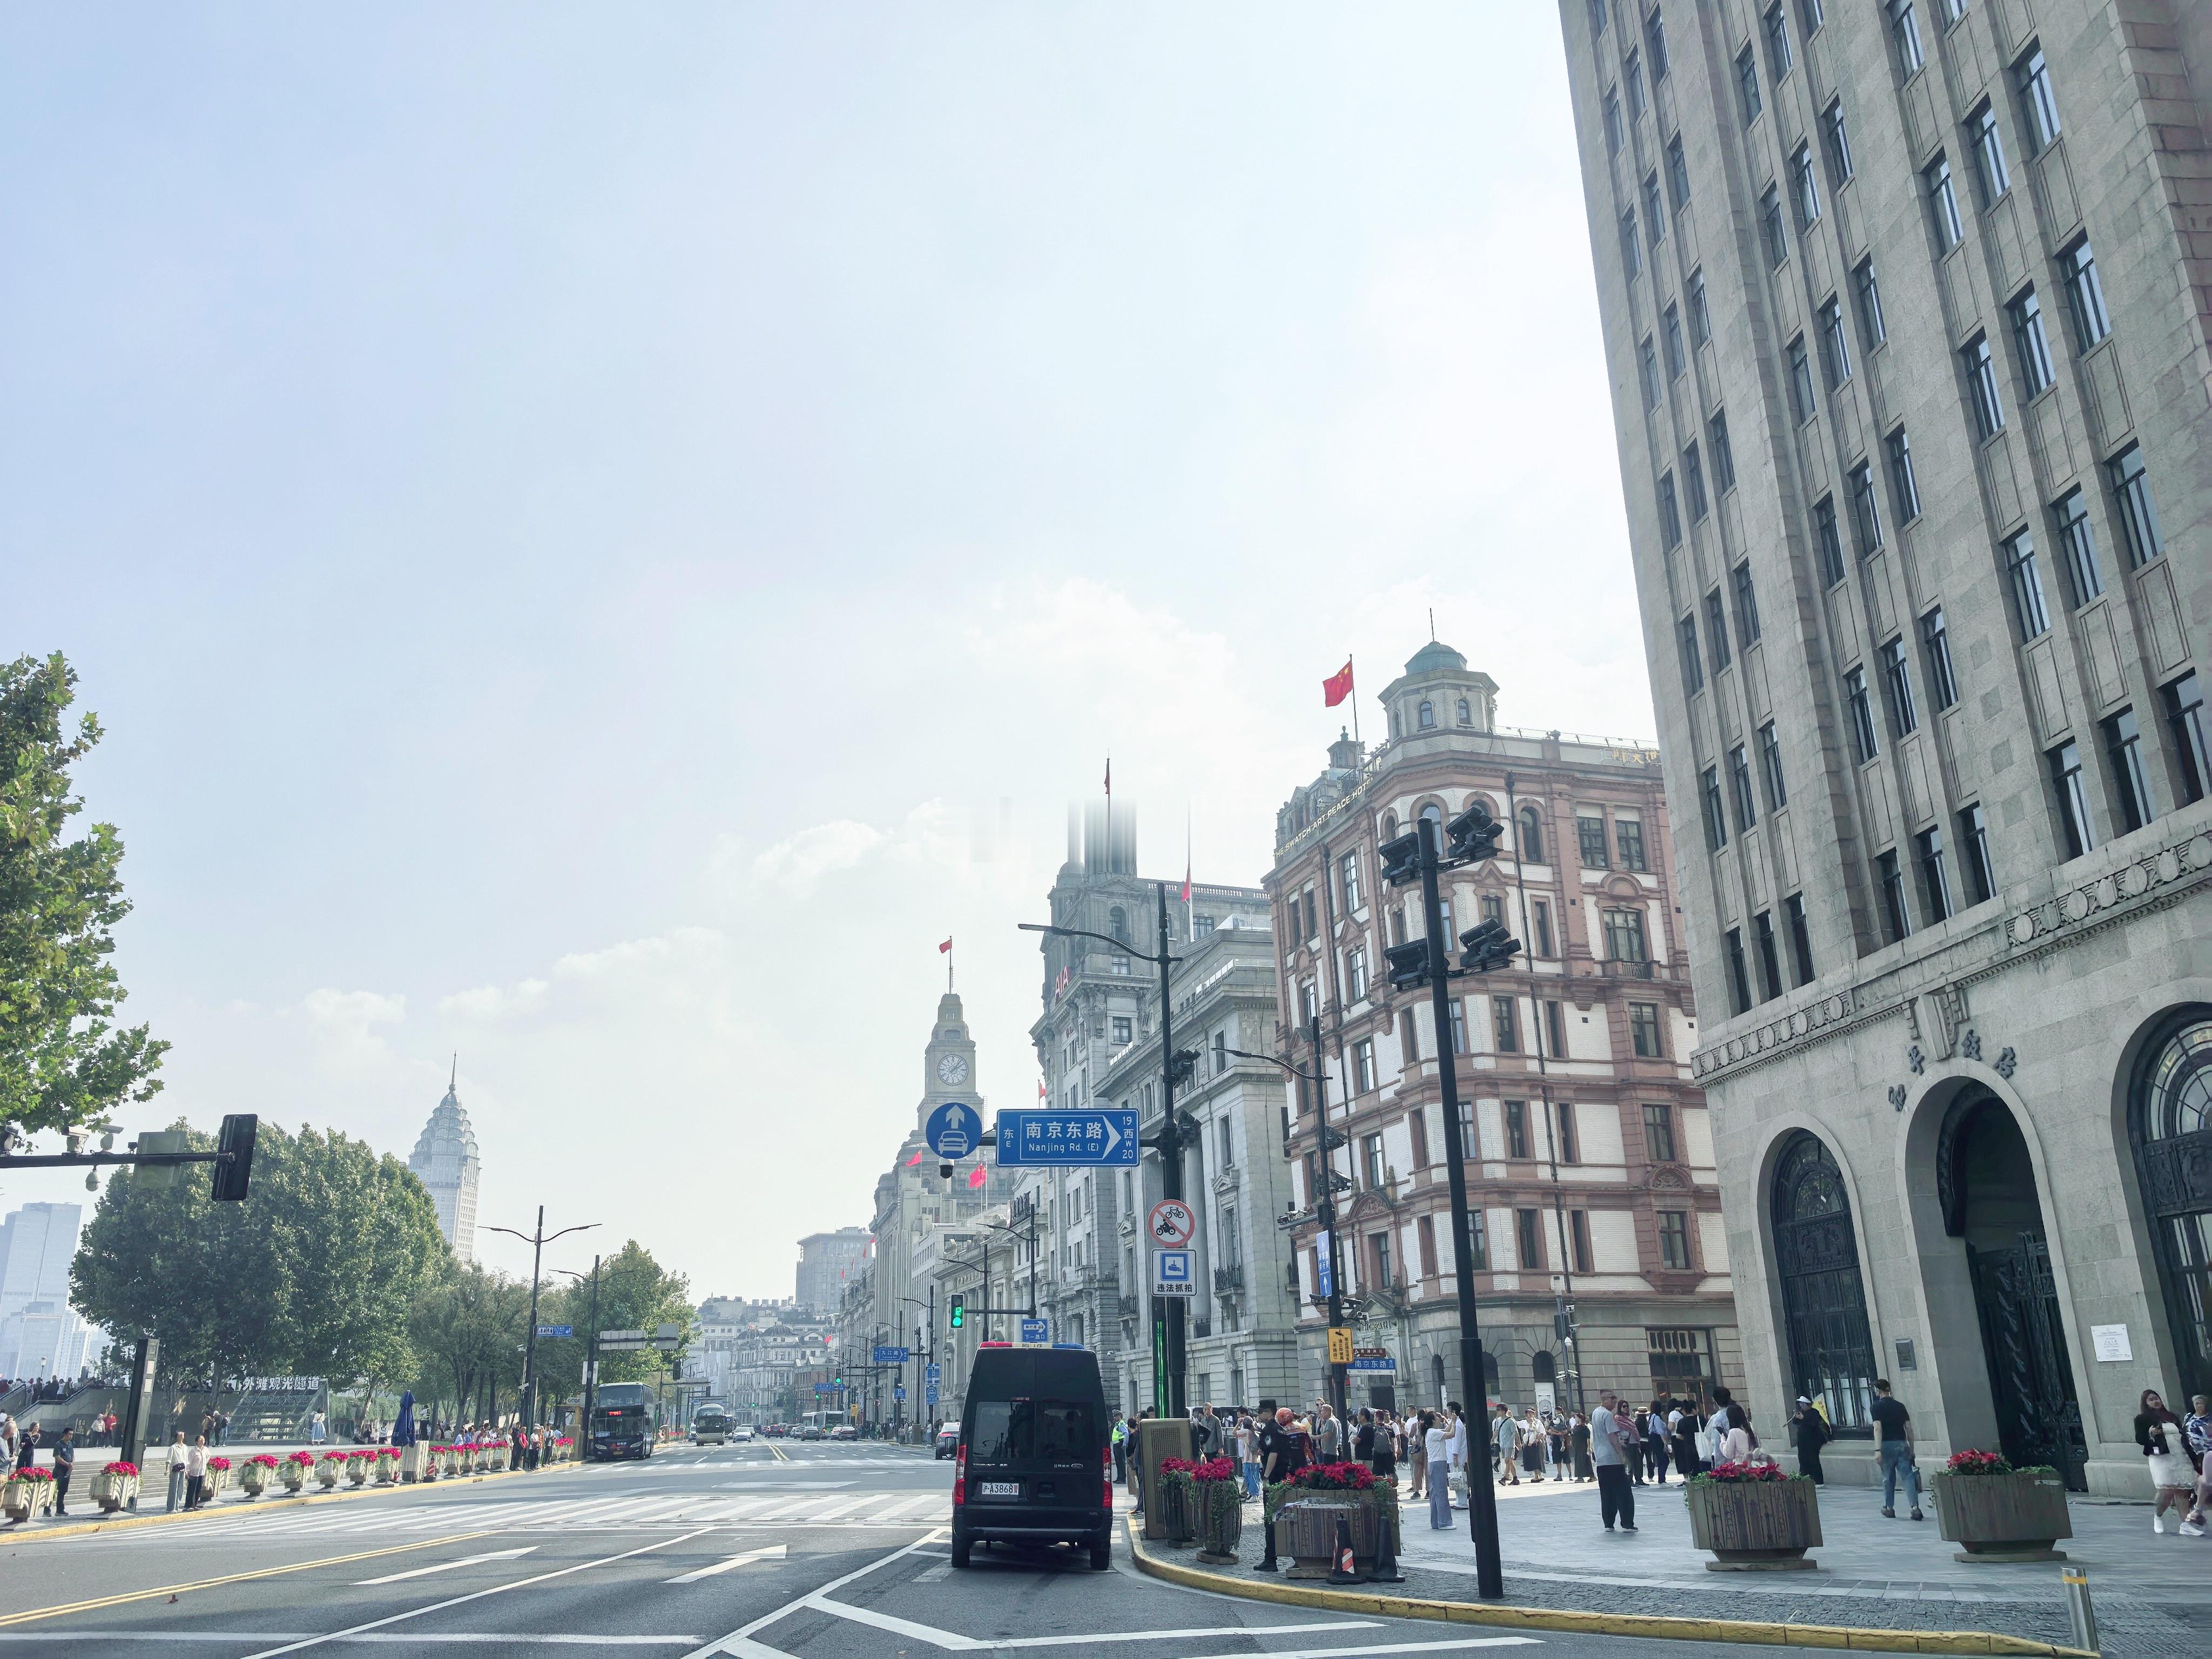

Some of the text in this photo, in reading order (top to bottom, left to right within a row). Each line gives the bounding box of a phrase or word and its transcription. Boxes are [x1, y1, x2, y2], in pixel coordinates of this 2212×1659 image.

[1285, 825, 1311, 851] SWATCH
[1313, 813, 1326, 830] ART
[1327, 795, 1351, 817] PEACE
[1055, 965, 1070, 1003] AIA
[1123, 1116, 1132, 1125] 19
[1003, 1128, 1014, 1139] 东
[1026, 1122, 1103, 1139] 南京东路
[1123, 1129, 1134, 1139] 西
[1029, 1143, 1099, 1154] Nanjing Rd. (E)
[1122, 1150, 1134, 1159] 20
[1157, 1283, 1192, 1292] 违法抓拍
[1354, 1360, 1387, 1368] 南京东路
[243, 1376, 320, 1391] 外滩观光隧道
